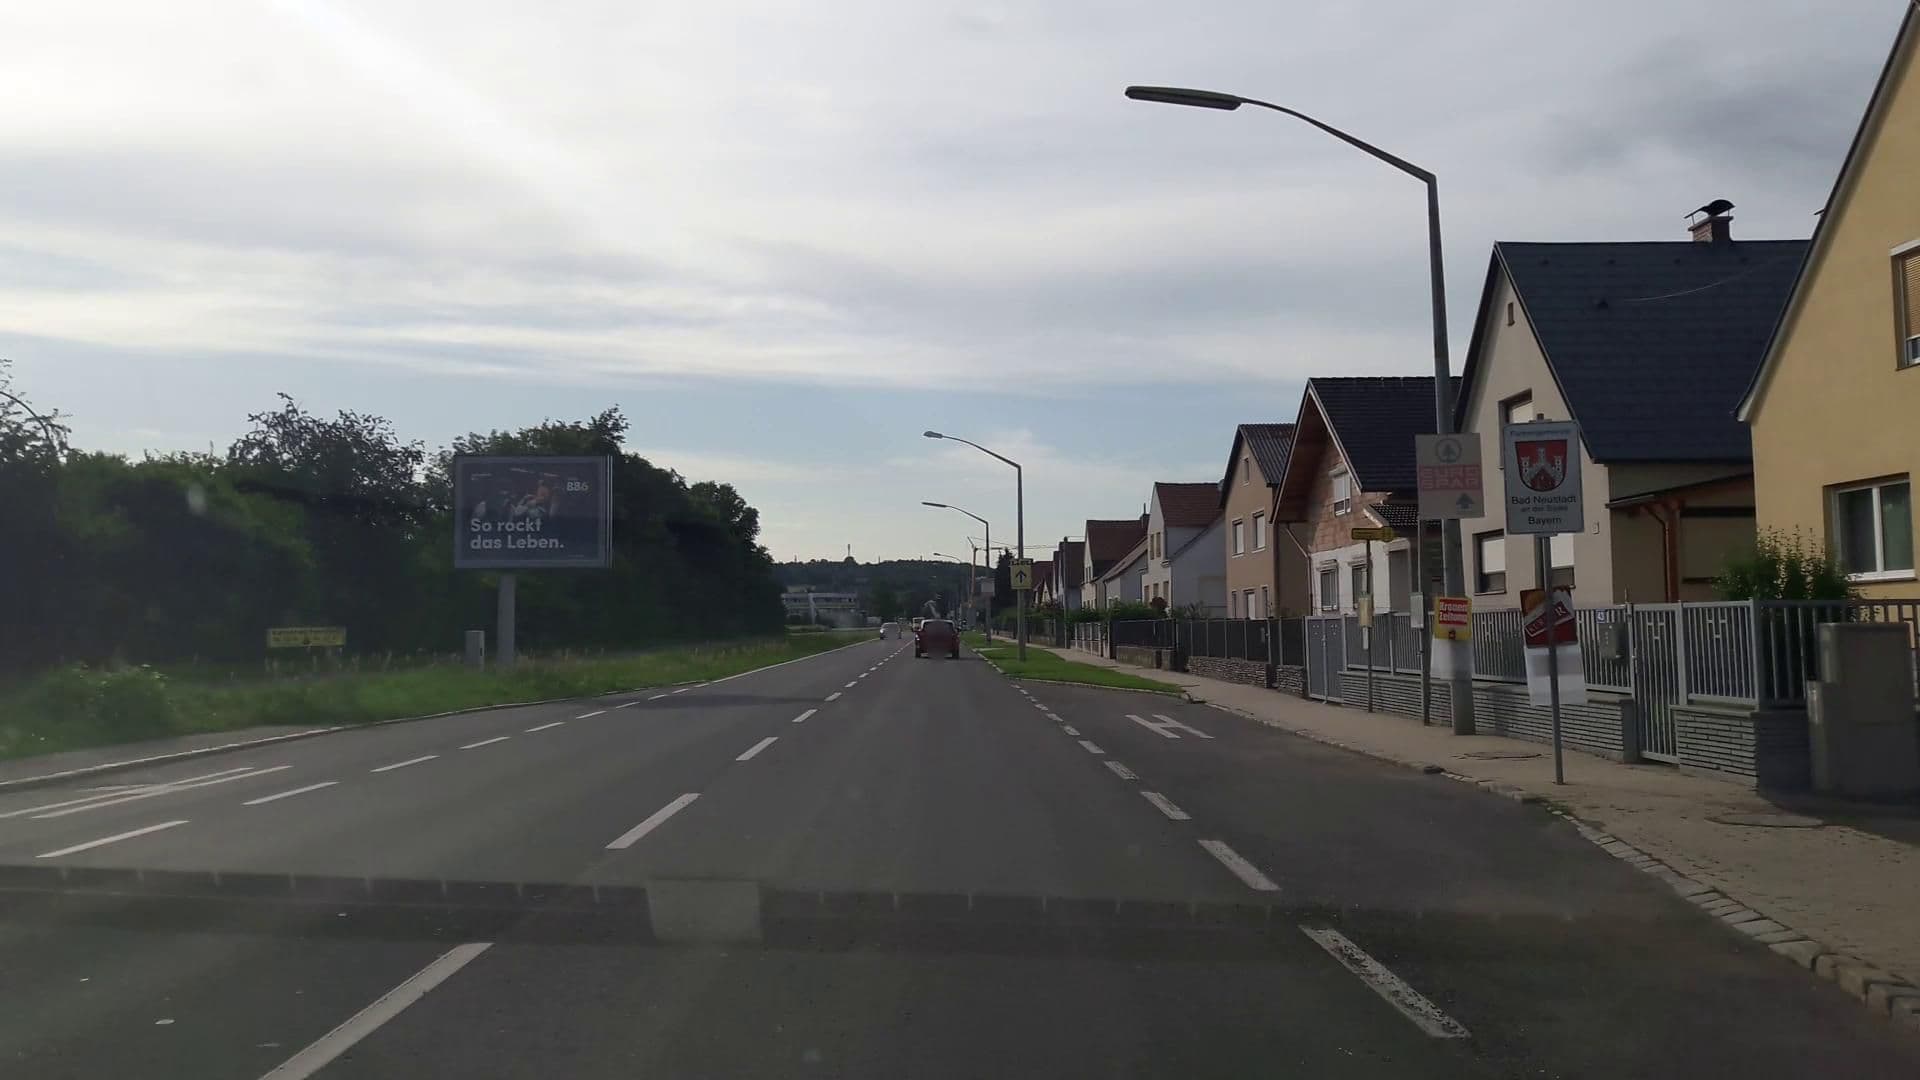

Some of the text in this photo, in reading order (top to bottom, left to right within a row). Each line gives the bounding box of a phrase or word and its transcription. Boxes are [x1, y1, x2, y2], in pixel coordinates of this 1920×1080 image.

[1511, 495, 1577, 505] Bad Neustadt
[470, 517, 542, 532] So rockt
[1528, 516, 1562, 526] Bayern
[470, 534, 565, 549] das Leben.
